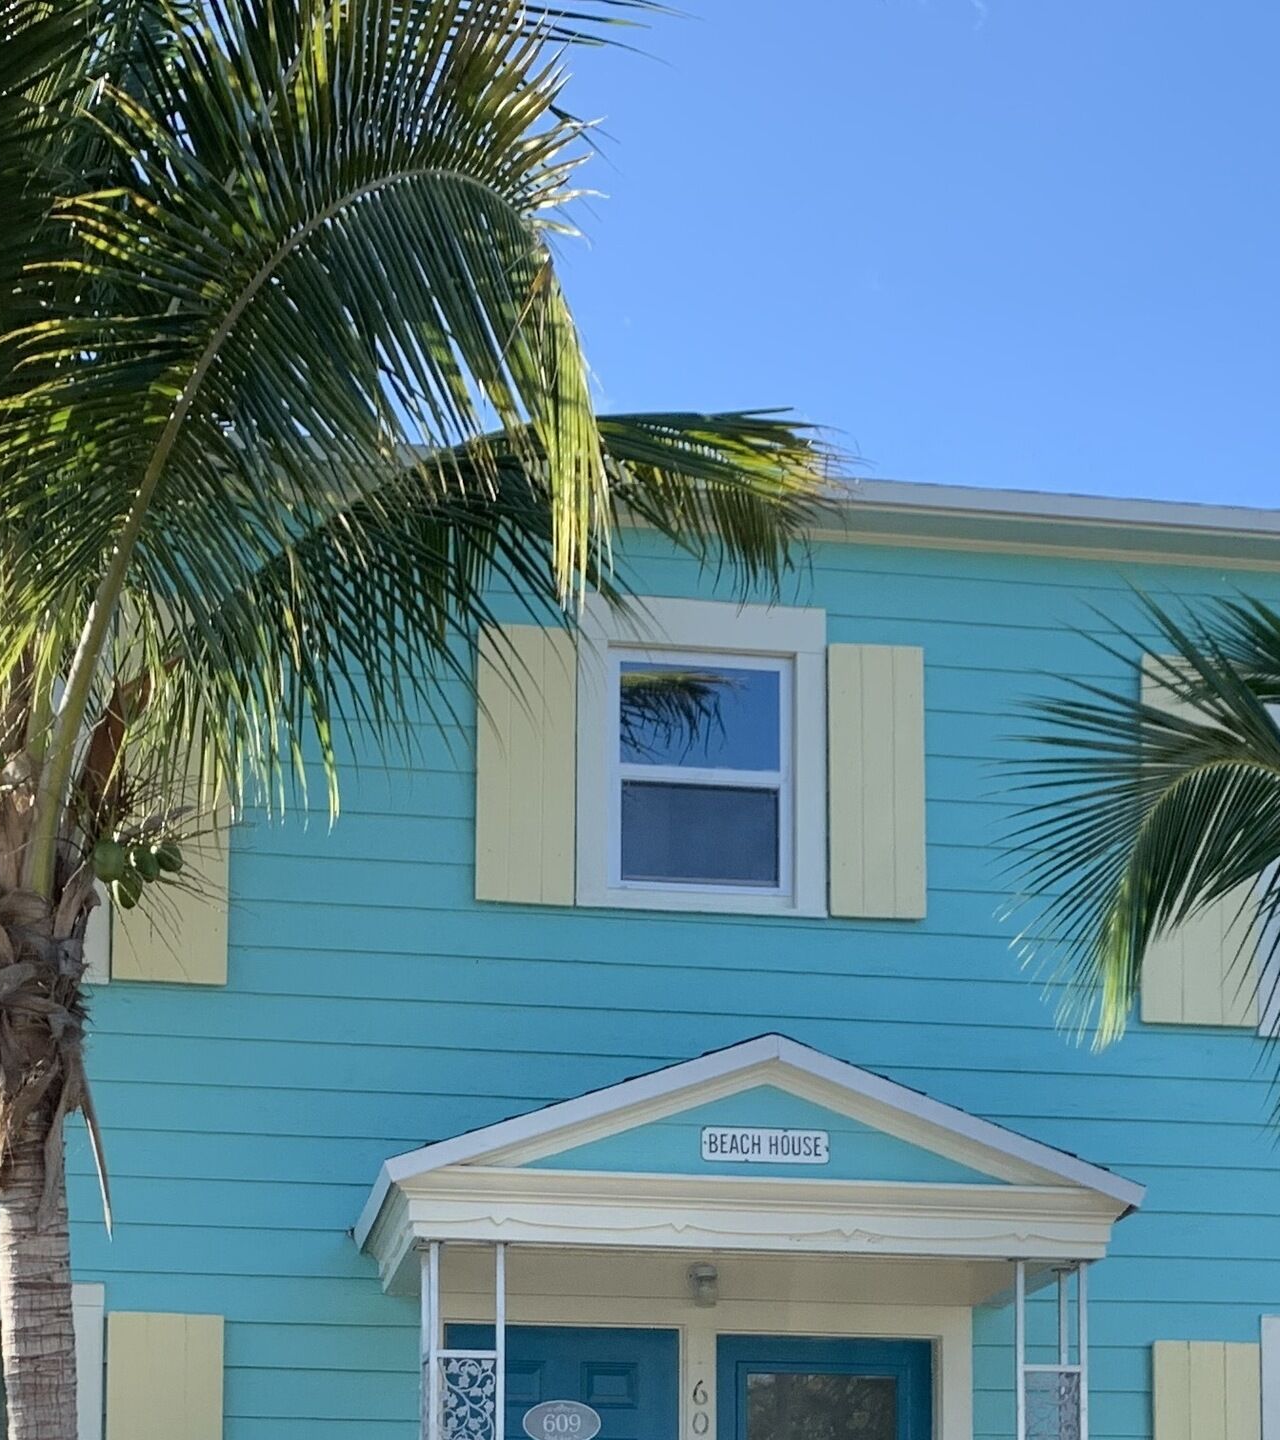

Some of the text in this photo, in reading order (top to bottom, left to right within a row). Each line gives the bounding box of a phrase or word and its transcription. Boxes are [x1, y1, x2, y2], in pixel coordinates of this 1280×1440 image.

[708, 1132, 823, 1157] BEACH HOUSE
[542, 1413, 581, 1433] 609
